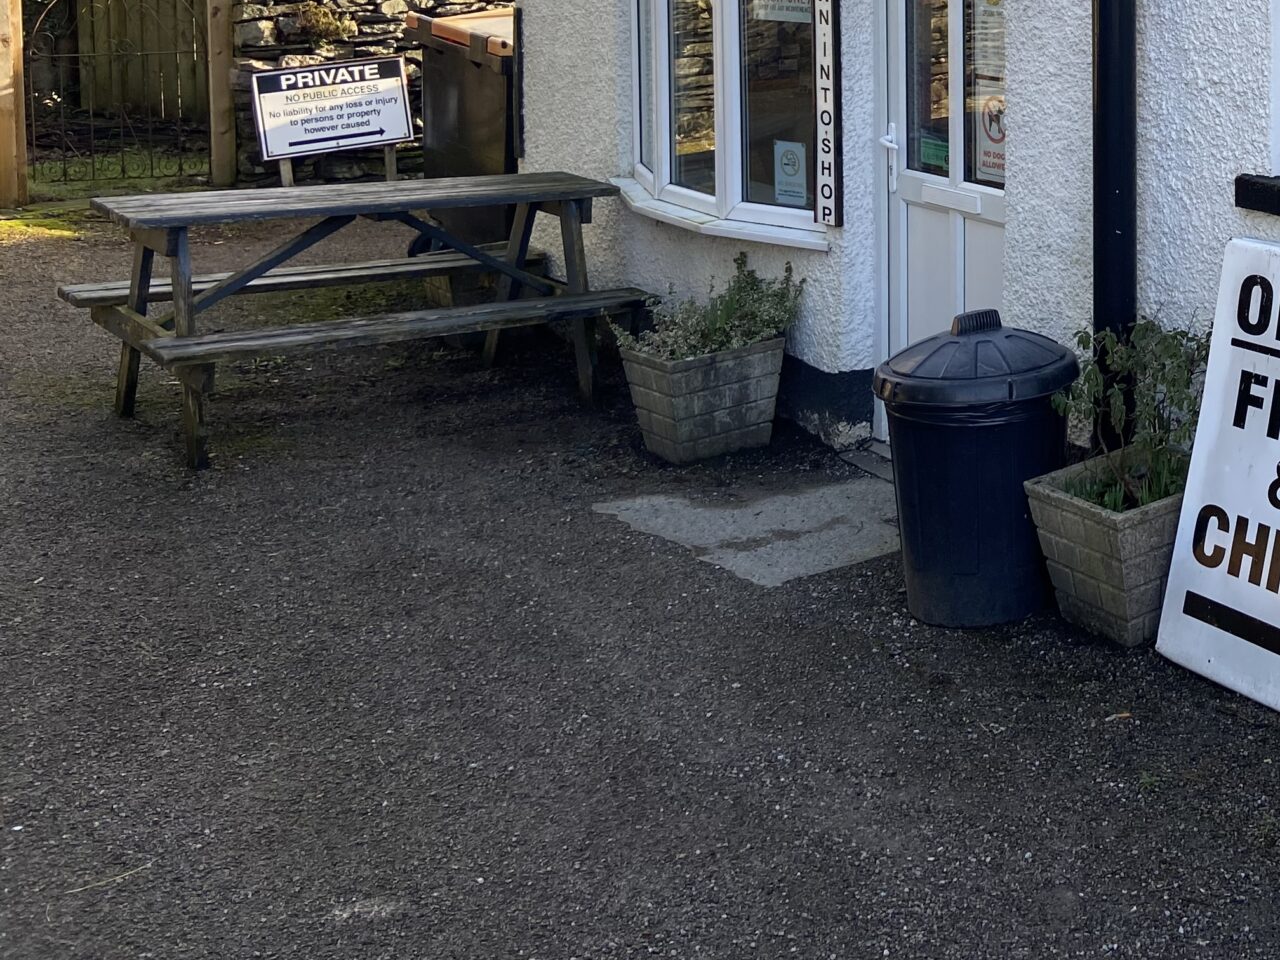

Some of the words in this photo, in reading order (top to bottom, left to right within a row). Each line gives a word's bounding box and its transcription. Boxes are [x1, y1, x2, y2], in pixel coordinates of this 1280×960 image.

[280, 64, 381, 90] PRIVATE
[285, 94, 300, 103] NO
[303, 89, 338, 101] PUBLIC
[341, 84, 380, 96] ACCESS
[269, 111, 281, 119] No
[283, 105, 313, 117] liability
[315, 104, 327, 113] for
[329, 102, 344, 112] any
[345, 100, 363, 109] loss
[375, 95, 398, 106] injury
[290, 119, 299, 127] to
[300, 114, 334, 128] persons
[336, 112, 345, 120] or
[346, 108, 381, 123] property
[304, 123, 339, 135] however
[341, 119, 371, 131] caused
